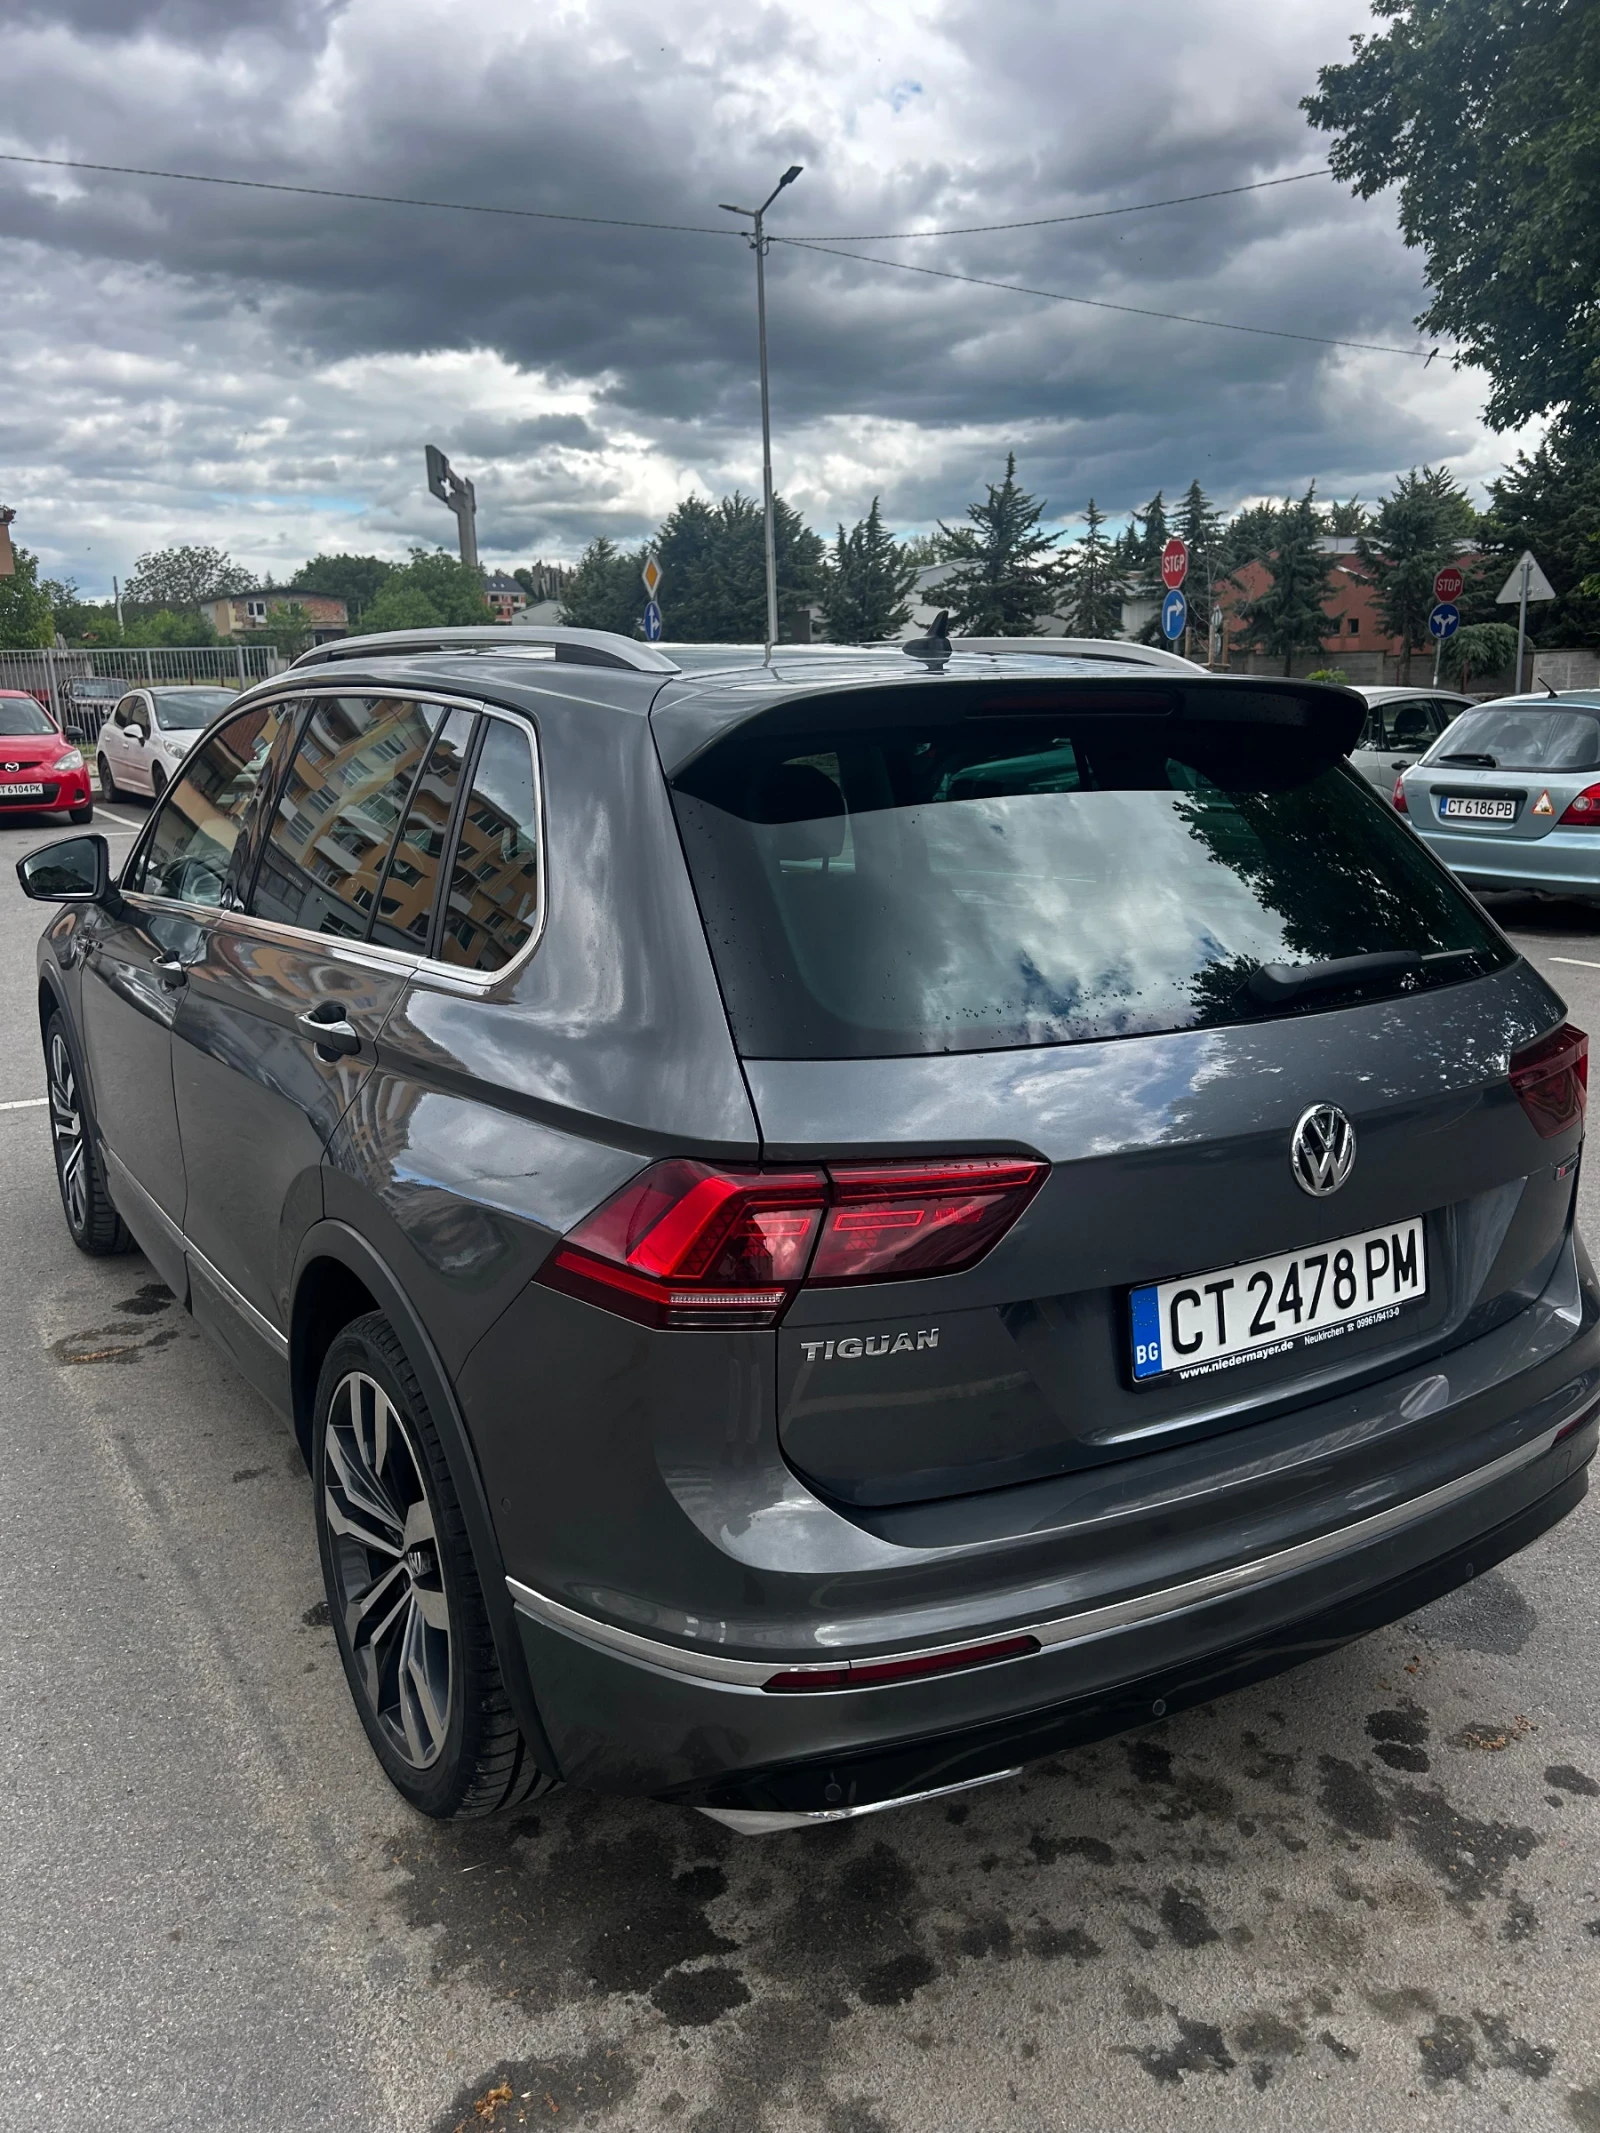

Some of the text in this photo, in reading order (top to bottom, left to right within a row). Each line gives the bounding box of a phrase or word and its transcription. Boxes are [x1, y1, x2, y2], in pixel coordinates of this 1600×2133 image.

[1164, 554, 1185, 573] STOP
[1437, 578, 1460, 592] STOP
[8, 785, 29, 794] 6104
[30, 784, 41, 793] PK
[1448, 800, 1464, 813] CT
[1465, 801, 1494, 815] 6186
[1495, 802, 1512, 816] PB
[1170, 1228, 1419, 1355] CT 2478 PM
[800, 1328, 940, 1362] TIGUAN
[1136, 1342, 1159, 1365] BG
[1180, 1340, 1294, 1380] www.niedermayer.de
[1304, 1326, 1345, 1346] Neukirchen
